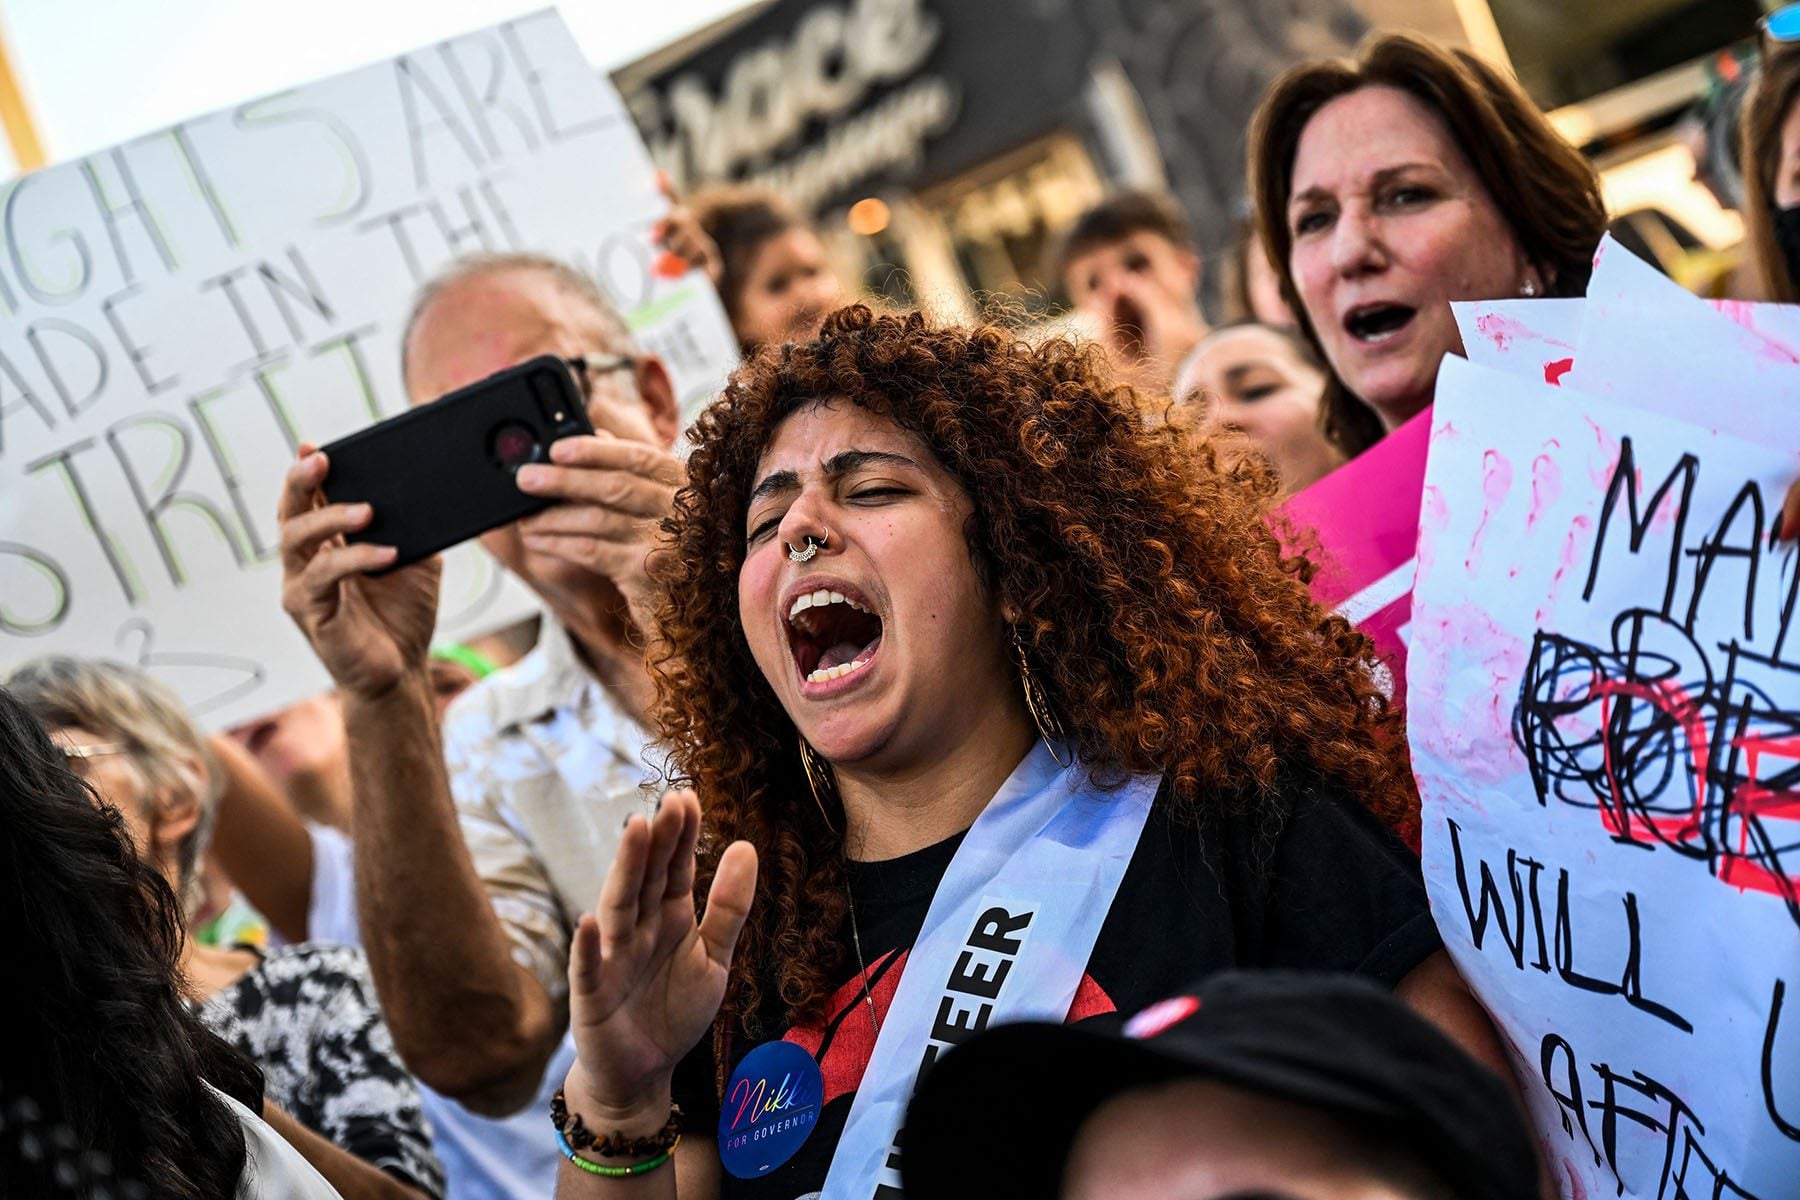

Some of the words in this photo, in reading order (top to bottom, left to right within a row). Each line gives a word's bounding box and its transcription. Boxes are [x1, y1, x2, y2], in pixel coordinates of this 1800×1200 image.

[0, 88, 373, 313] GHTS
[392, 10, 618, 194] ARE
[199, 242, 336, 375] IN
[1447, 817, 1694, 1034] WILL
[727, 1134, 747, 1151] FOR
[753, 1110, 815, 1142] GOVERNOR
